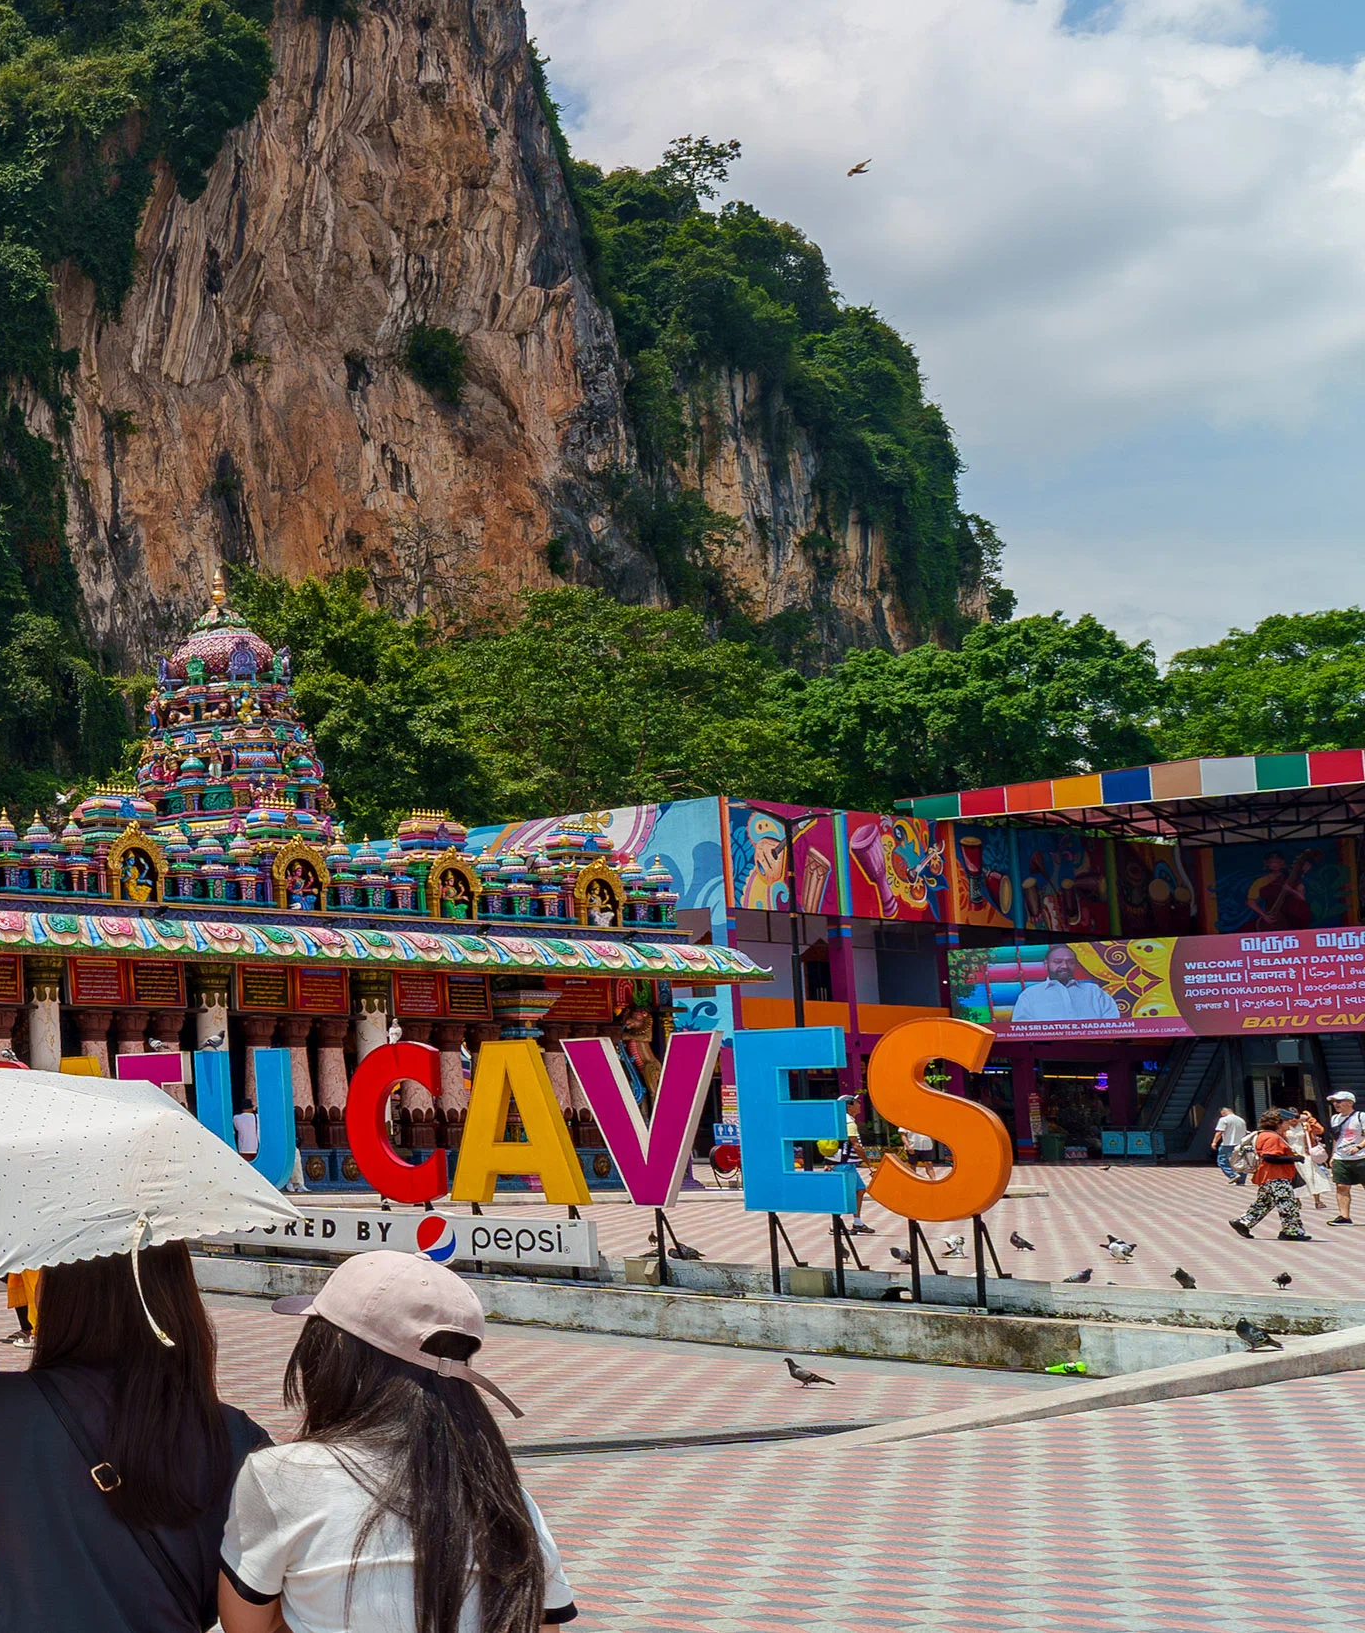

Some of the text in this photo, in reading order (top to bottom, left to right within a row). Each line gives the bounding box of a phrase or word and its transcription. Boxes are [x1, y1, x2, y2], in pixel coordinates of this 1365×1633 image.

[1315, 931, 1365, 950] வரு
[1184, 954, 1364, 969] WELCOME SELAMAT DATANG
[1184, 985, 1294, 998] ДОБРО ПОЖАЛОВАТЬ
[1242, 1013, 1365, 1028] BATU CAV
[346, 1017, 1013, 1221] CAVES
[357, 1221, 393, 1243] BY
[472, 1224, 563, 1258] pepsi
